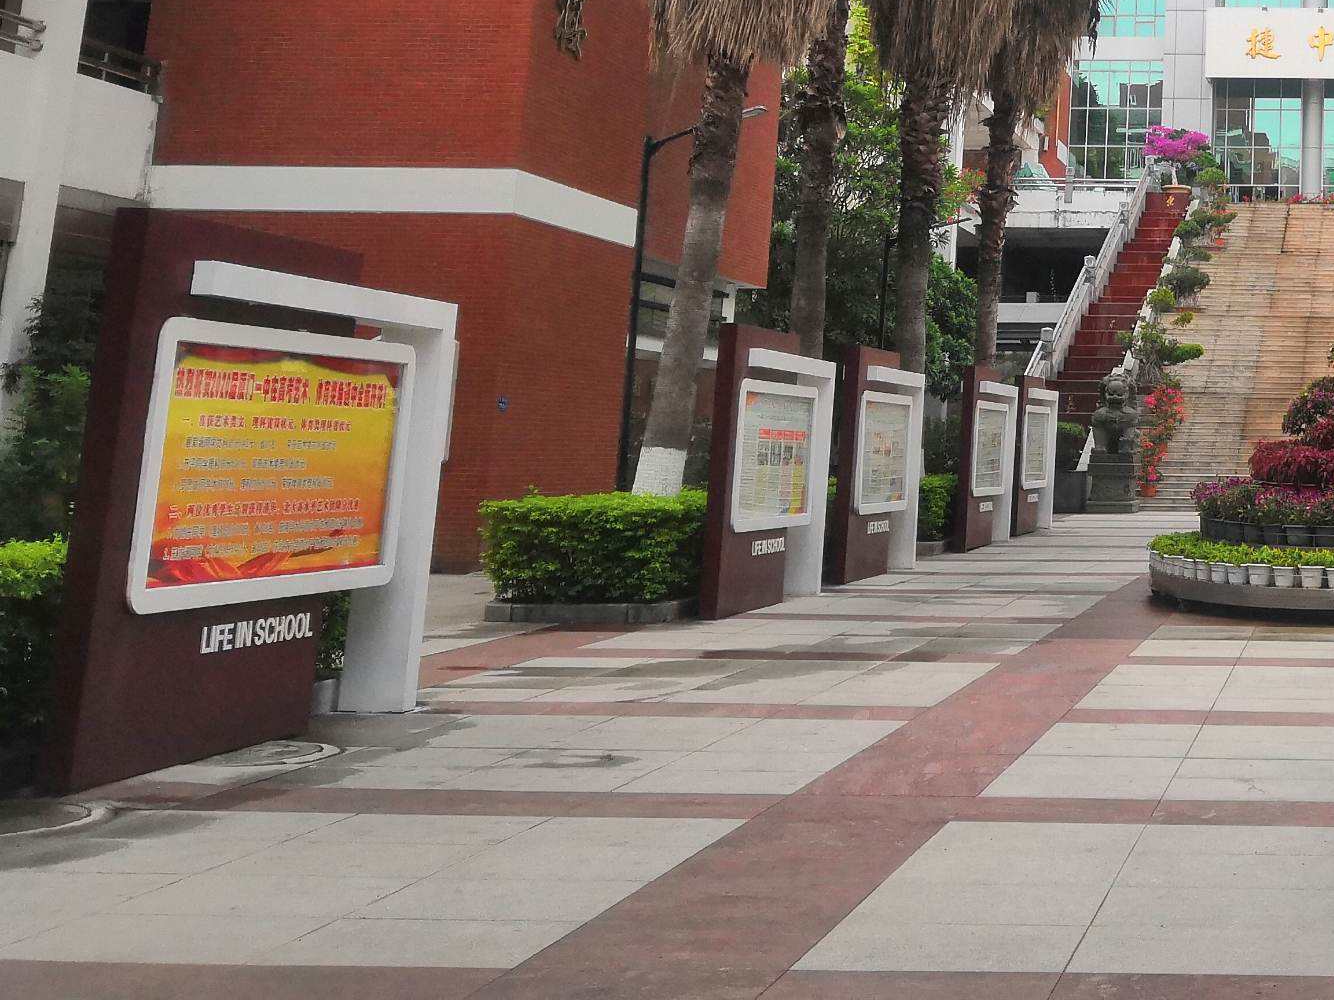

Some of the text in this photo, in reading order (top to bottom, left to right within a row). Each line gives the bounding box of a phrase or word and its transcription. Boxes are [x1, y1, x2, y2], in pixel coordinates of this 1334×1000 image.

[200, 612, 313, 655] LIFE IN SCHOOL
